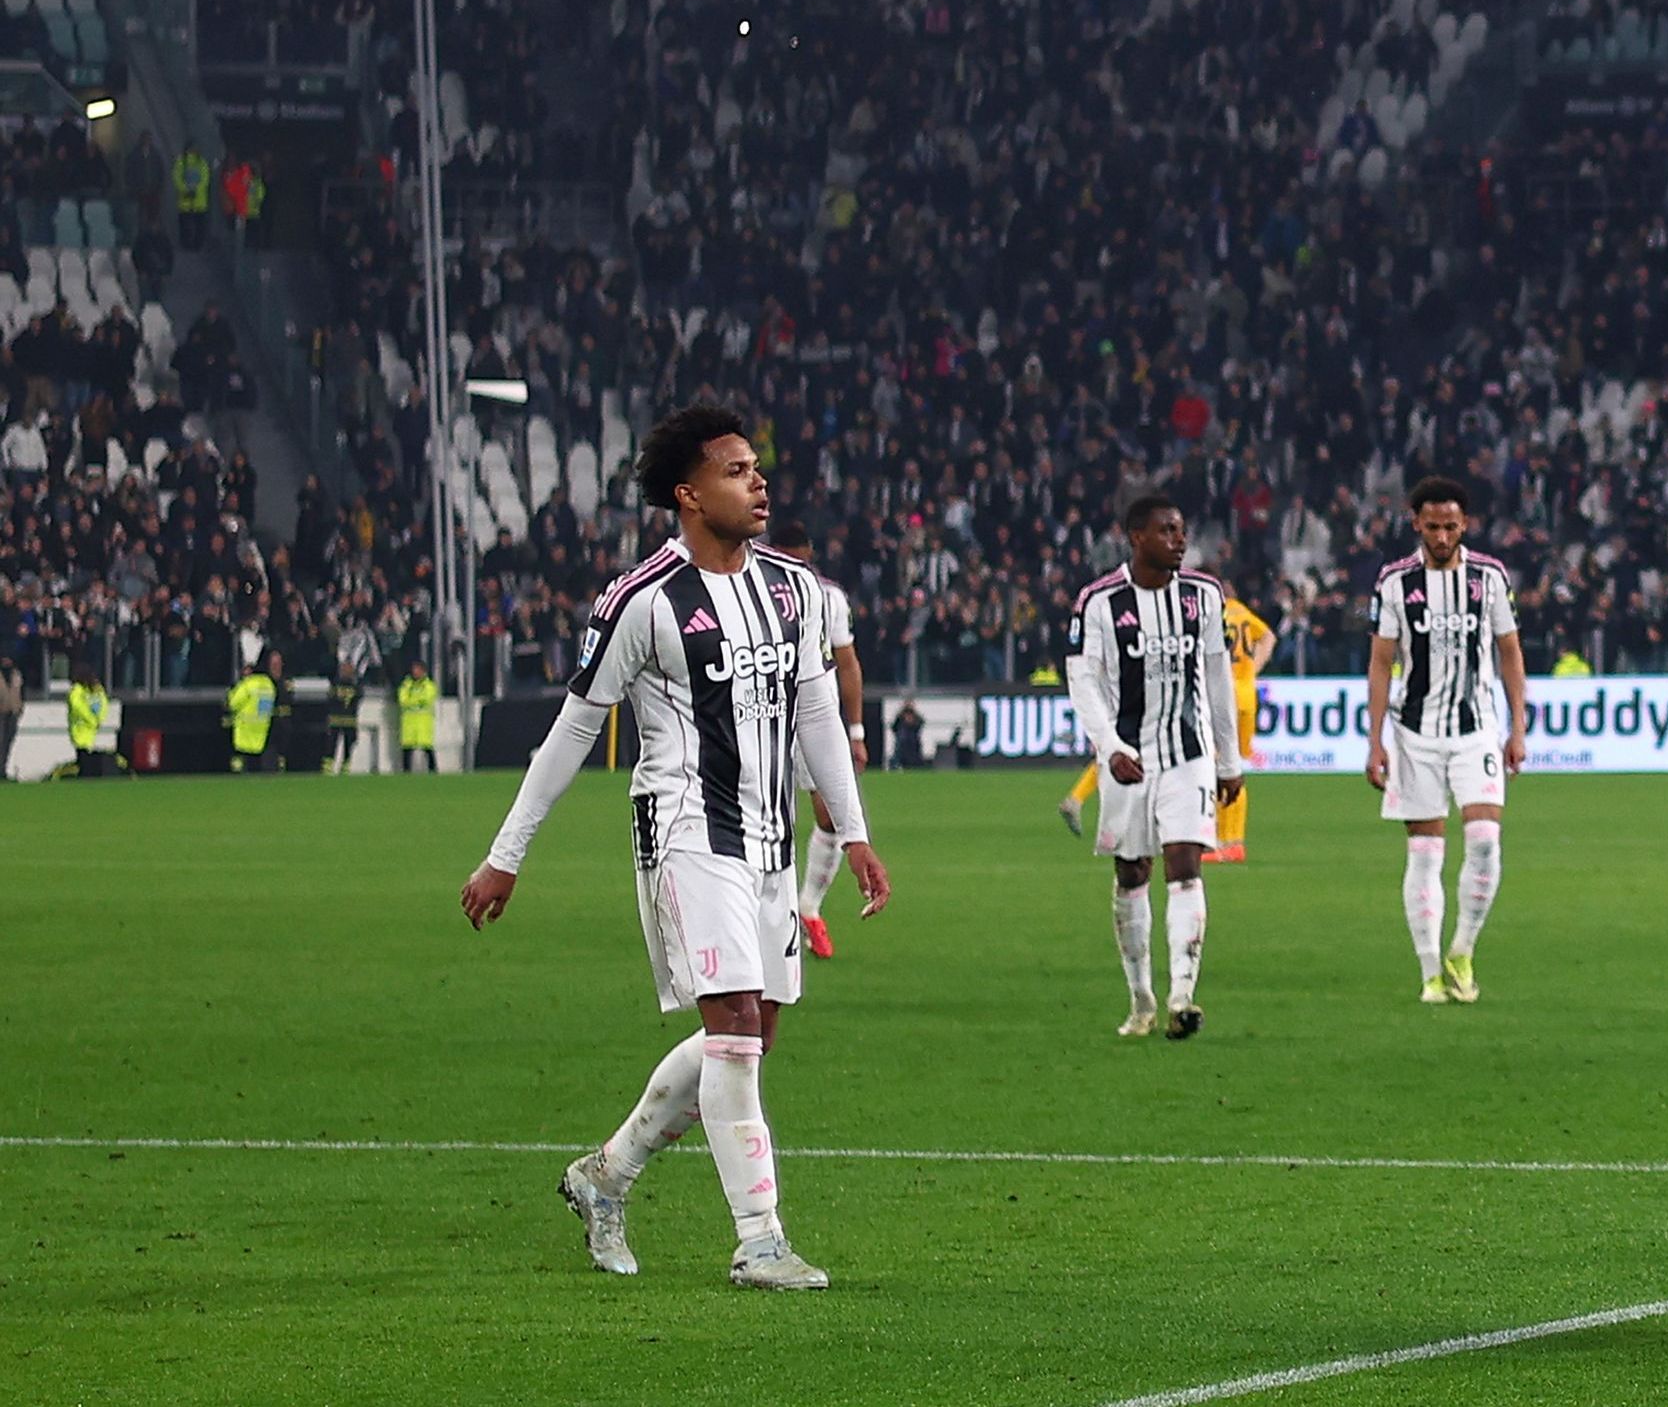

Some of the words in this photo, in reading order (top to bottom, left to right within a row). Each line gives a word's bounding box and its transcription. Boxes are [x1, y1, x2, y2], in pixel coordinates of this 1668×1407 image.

[1413, 608, 1478, 633] Jeep
[1126, 630, 1195, 659] Jeep
[704, 639, 797, 683] Jeep
[1256, 689, 1371, 738] bud
[1483, 752, 1498, 778] 6
